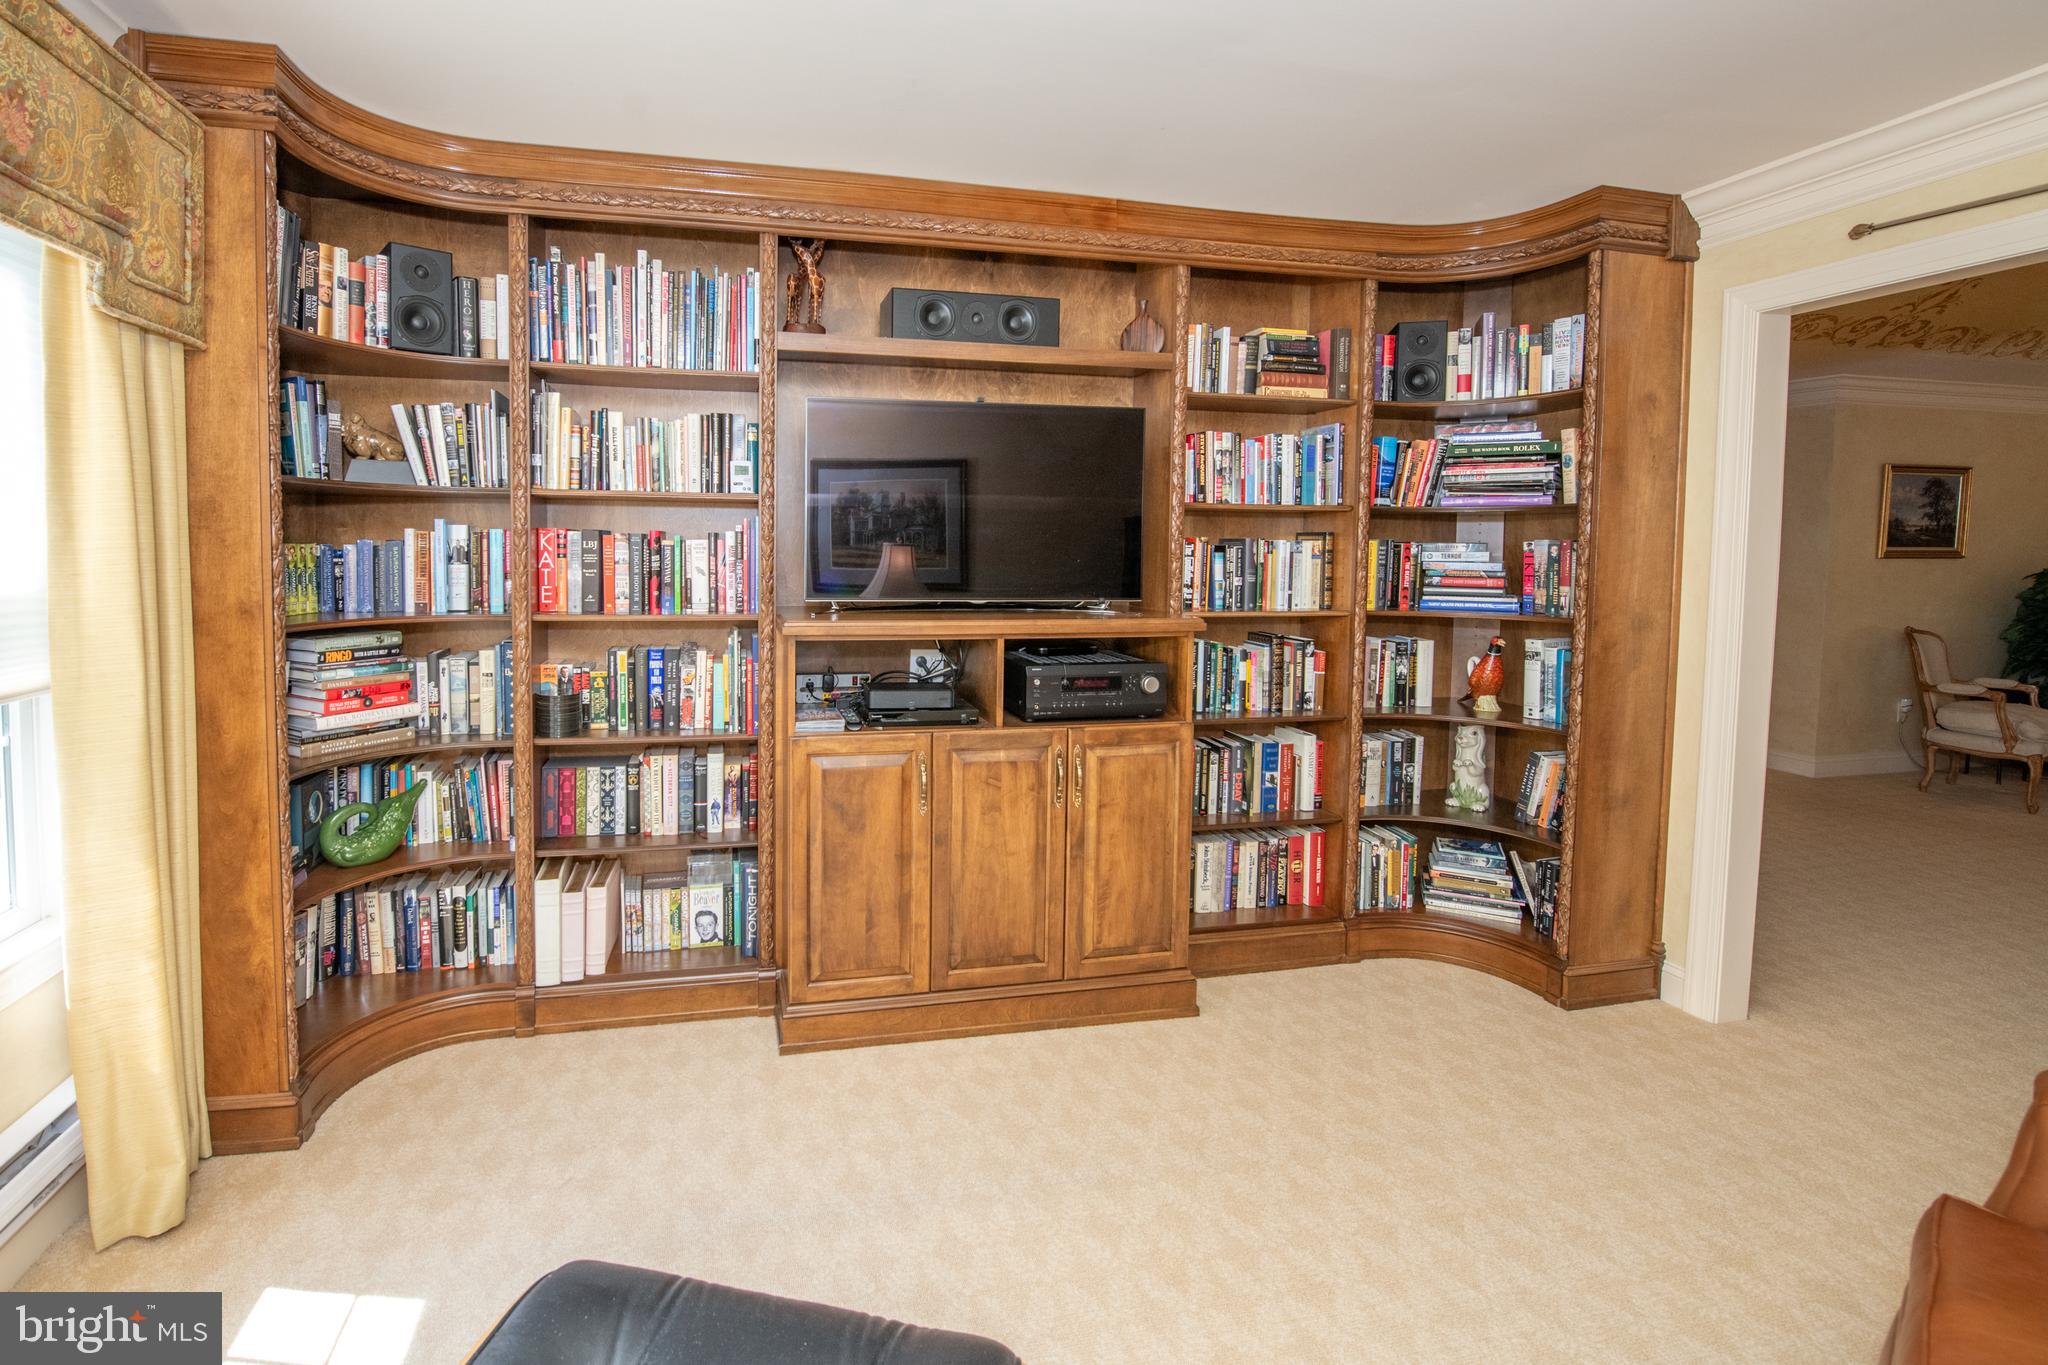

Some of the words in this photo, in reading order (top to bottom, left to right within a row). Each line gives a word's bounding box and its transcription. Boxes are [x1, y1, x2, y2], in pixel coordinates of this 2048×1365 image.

[583, 541, 598, 550] LBJ
[538, 532, 554, 604] KATE
[325, 650, 352, 663] RINGO
[1525, 766, 1536, 796] PRESIDENT
[1277, 858, 1285, 895] PLAYBOY
